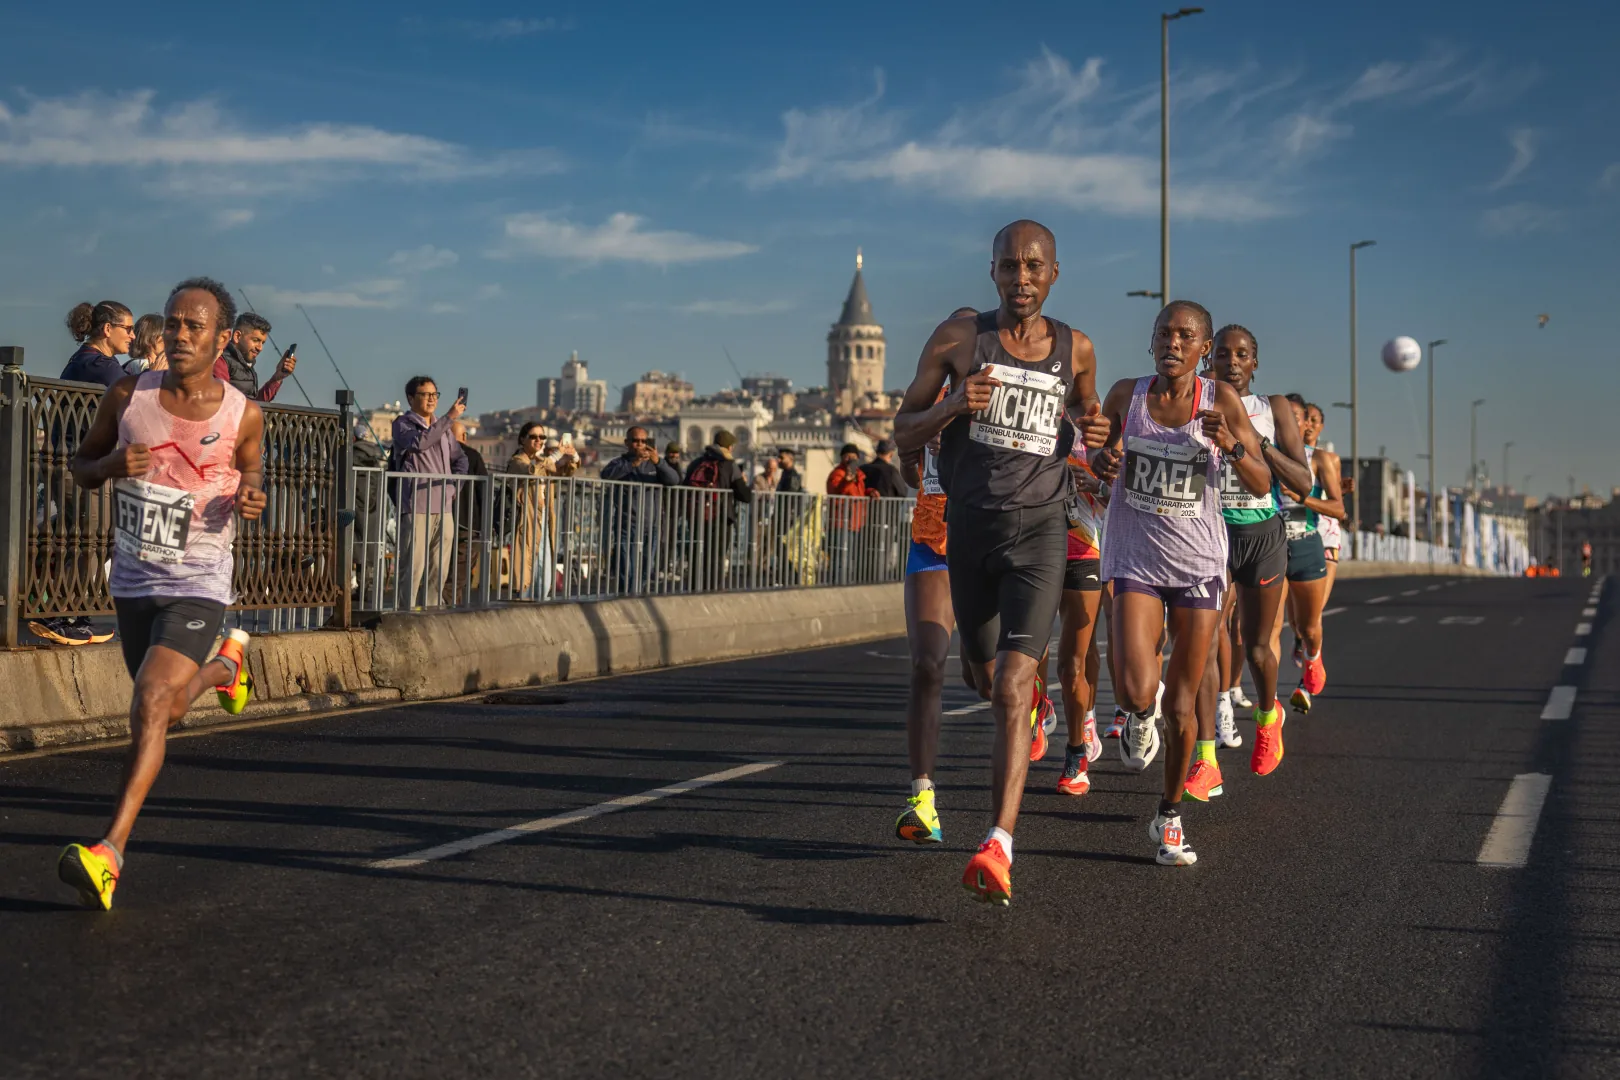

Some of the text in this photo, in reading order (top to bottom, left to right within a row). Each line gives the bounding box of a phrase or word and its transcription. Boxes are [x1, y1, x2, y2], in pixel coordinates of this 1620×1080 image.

[1056, 383, 1066, 396] 98
[976, 385, 1059, 435] MICHAEL
[978, 425, 1011, 438] ISTANBUL
[1012, 431, 1051, 445] MARATHON
[1037, 446, 1051, 454] 2025
[1195, 453, 1208, 463] 115
[1132, 455, 1196, 500] RAEL
[180, 498, 195, 510] 23
[1129, 491, 1156, 505] STANBUL
[1156, 499, 1194, 508] MARATHON
[117, 492, 186, 548] FETENE
